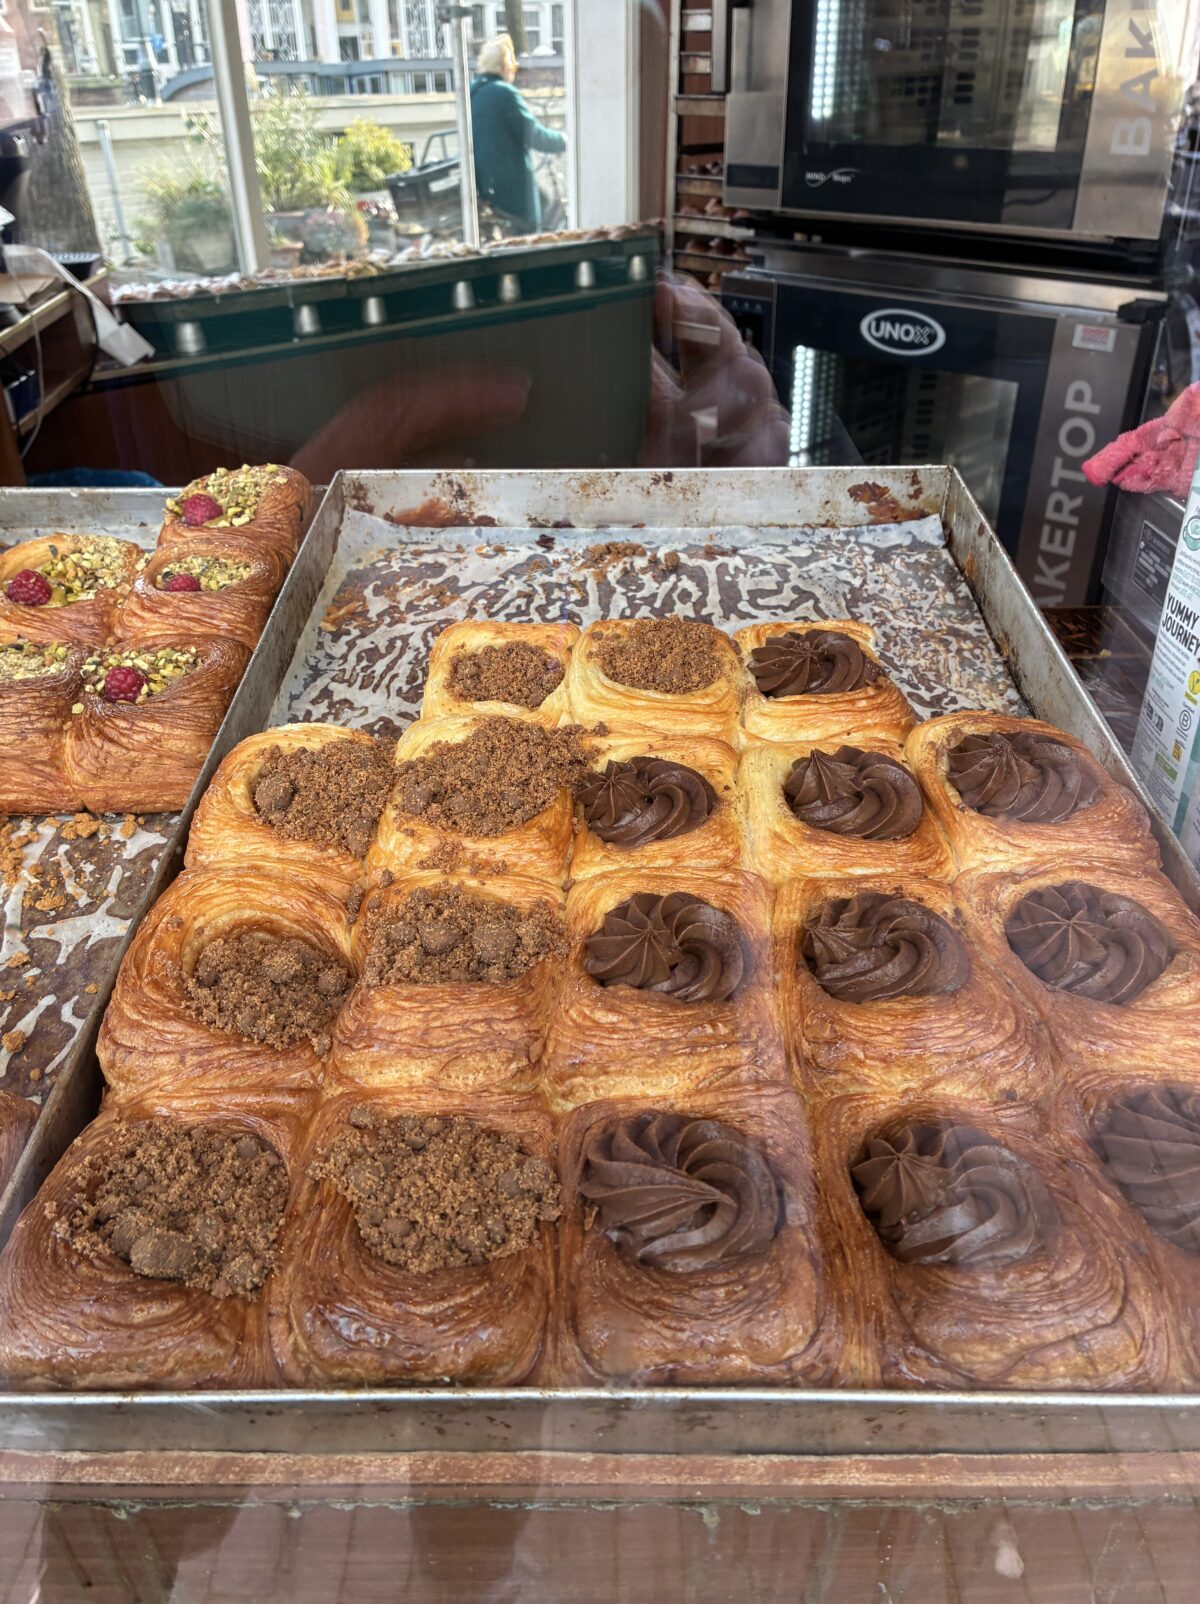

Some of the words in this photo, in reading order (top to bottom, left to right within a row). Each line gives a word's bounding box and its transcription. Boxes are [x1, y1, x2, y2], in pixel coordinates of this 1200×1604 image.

[870, 319, 931, 346] UNOX
[1166, 592, 1200, 630] YUMMY
[1162, 613, 1200, 656] JOURNEY
